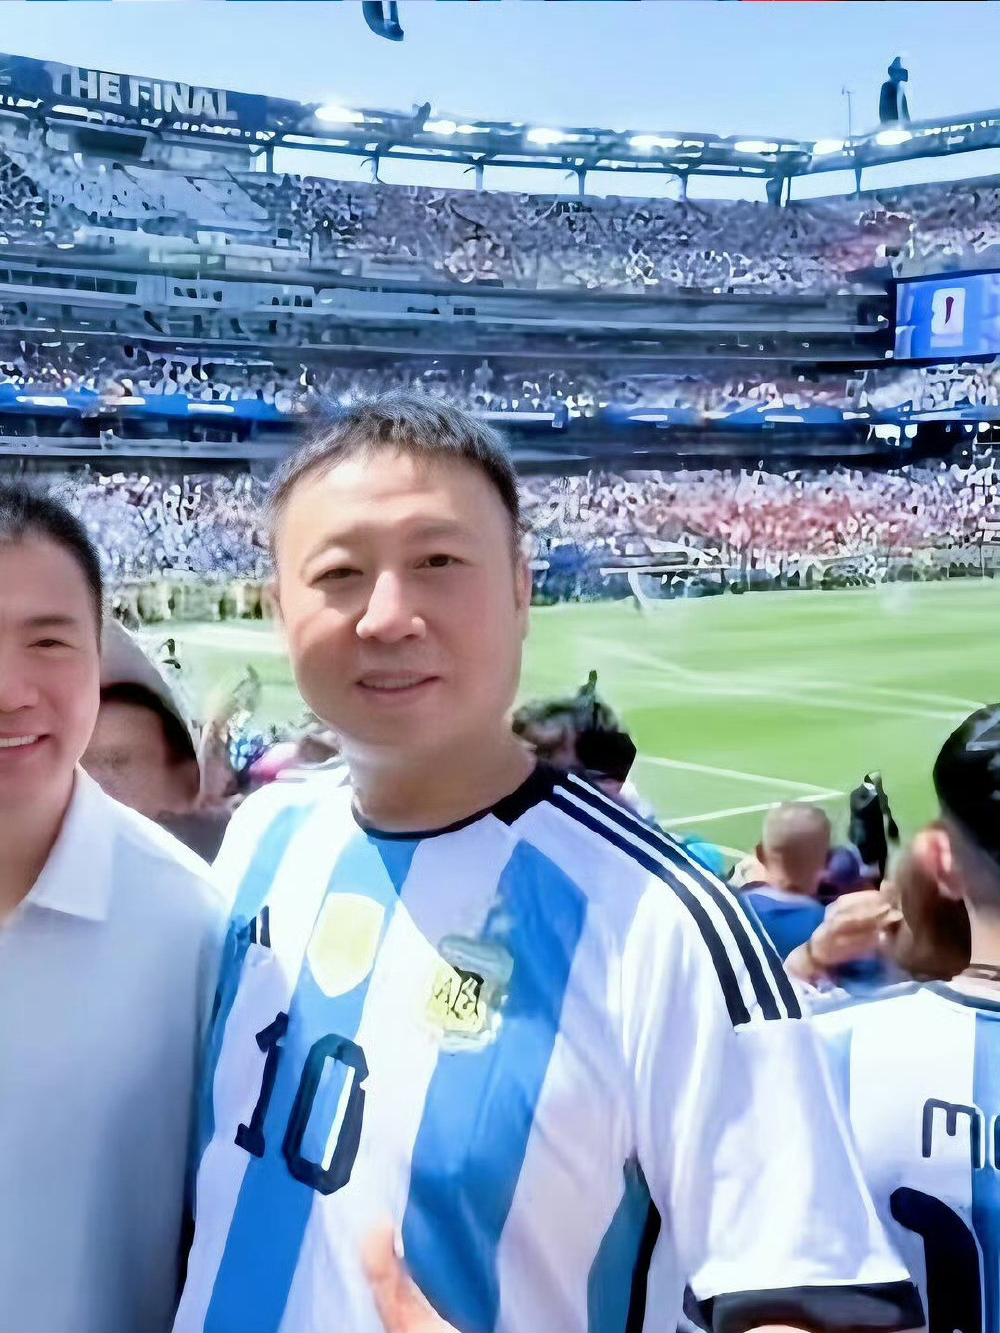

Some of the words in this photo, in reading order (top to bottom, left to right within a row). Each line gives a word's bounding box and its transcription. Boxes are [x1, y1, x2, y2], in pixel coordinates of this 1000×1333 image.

[44, 62, 122, 105] THE
[129, 75, 238, 121] FINAL
[234, 1011, 369, 1196] 10
